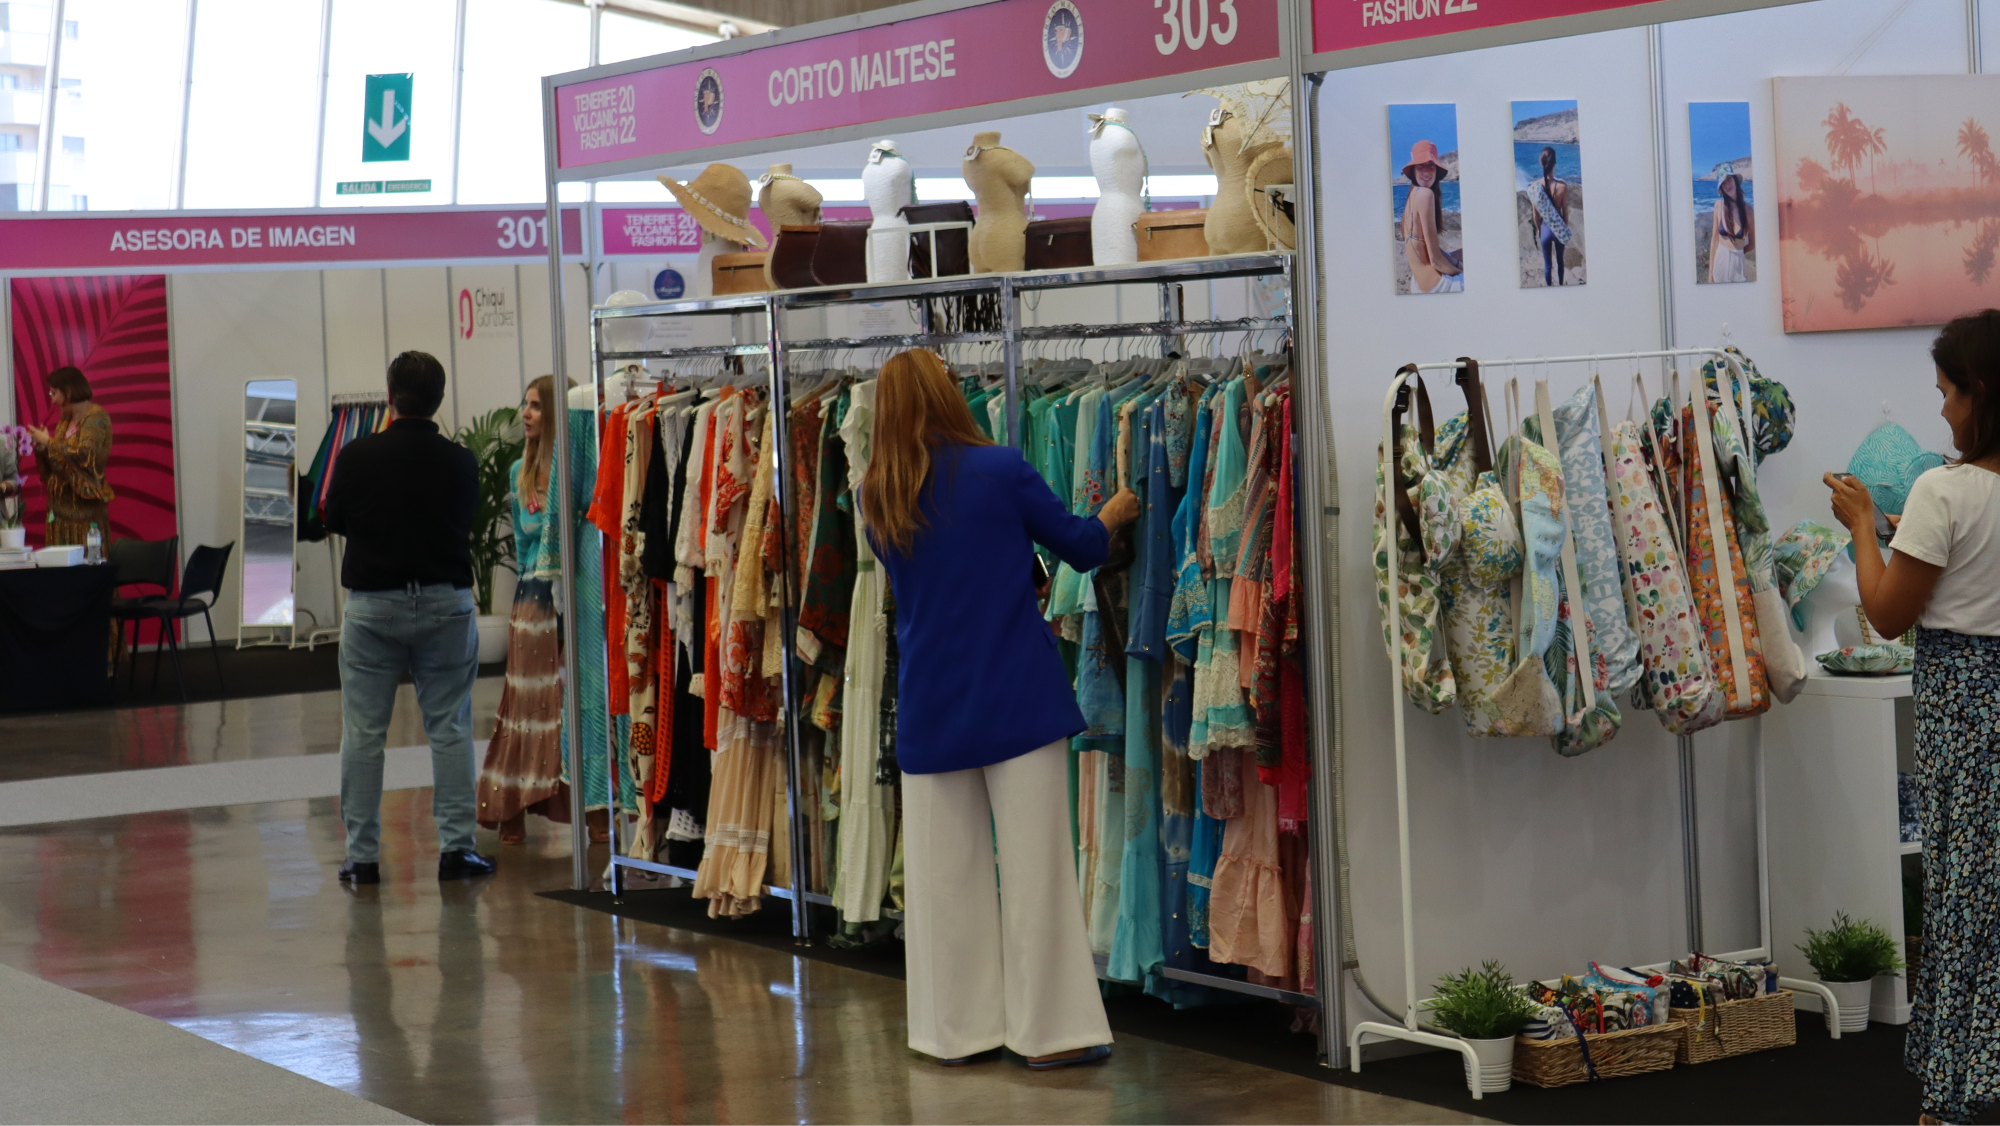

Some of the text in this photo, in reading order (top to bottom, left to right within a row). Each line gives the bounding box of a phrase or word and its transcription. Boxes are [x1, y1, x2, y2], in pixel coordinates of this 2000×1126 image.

[1362, 0, 1440, 27] FASHION
[1154, 0, 1238, 55] 303
[768, 59, 845, 108] CORTO
[850, 38, 956, 93] MALTESE
[574, 84, 636, 114] TENERIFE 20
[573, 108, 618, 133] VOLCANIC
[581, 116, 636, 150] FASHION 22
[341, 182, 430, 194] SALIDA EMERGENCIA
[623, 226, 676, 237] VOLCANIC
[626, 214, 697, 229] TENERIFE 20
[110, 226, 356, 251] ASESORA DE IMAGEN
[631, 231, 697, 248] FASHION 22
